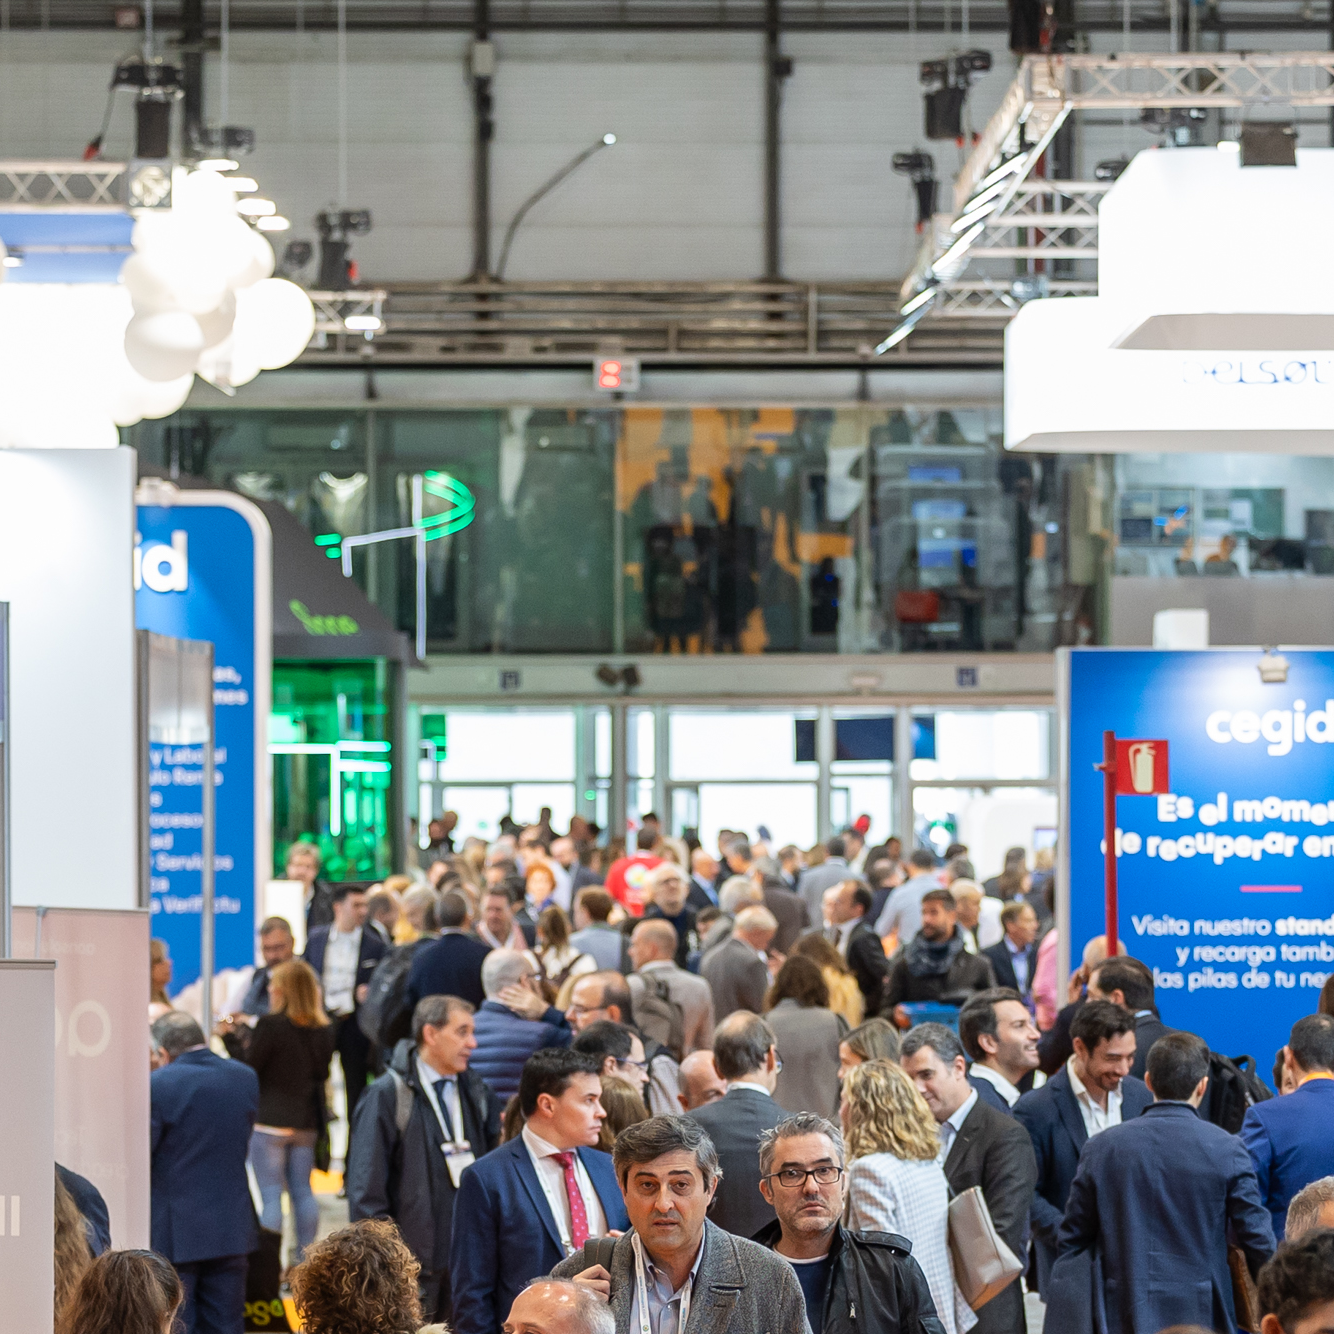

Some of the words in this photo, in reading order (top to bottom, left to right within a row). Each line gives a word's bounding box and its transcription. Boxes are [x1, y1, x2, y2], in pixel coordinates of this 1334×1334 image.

[1157, 793, 1195, 823] Es
[1198, 792, 1228, 827] el
[1147, 831, 1300, 866] recuperar
[1131, 914, 1190, 936] Visita
[1193, 917, 1273, 936] nuestro
[1175, 946, 1190, 967] y
[1193, 944, 1277, 967] recarga
[1153, 966, 1184, 989] las
[1188, 967, 1239, 993] pilas
[1241, 966, 1271, 989] de
[1274, 968, 1296, 989] tu
